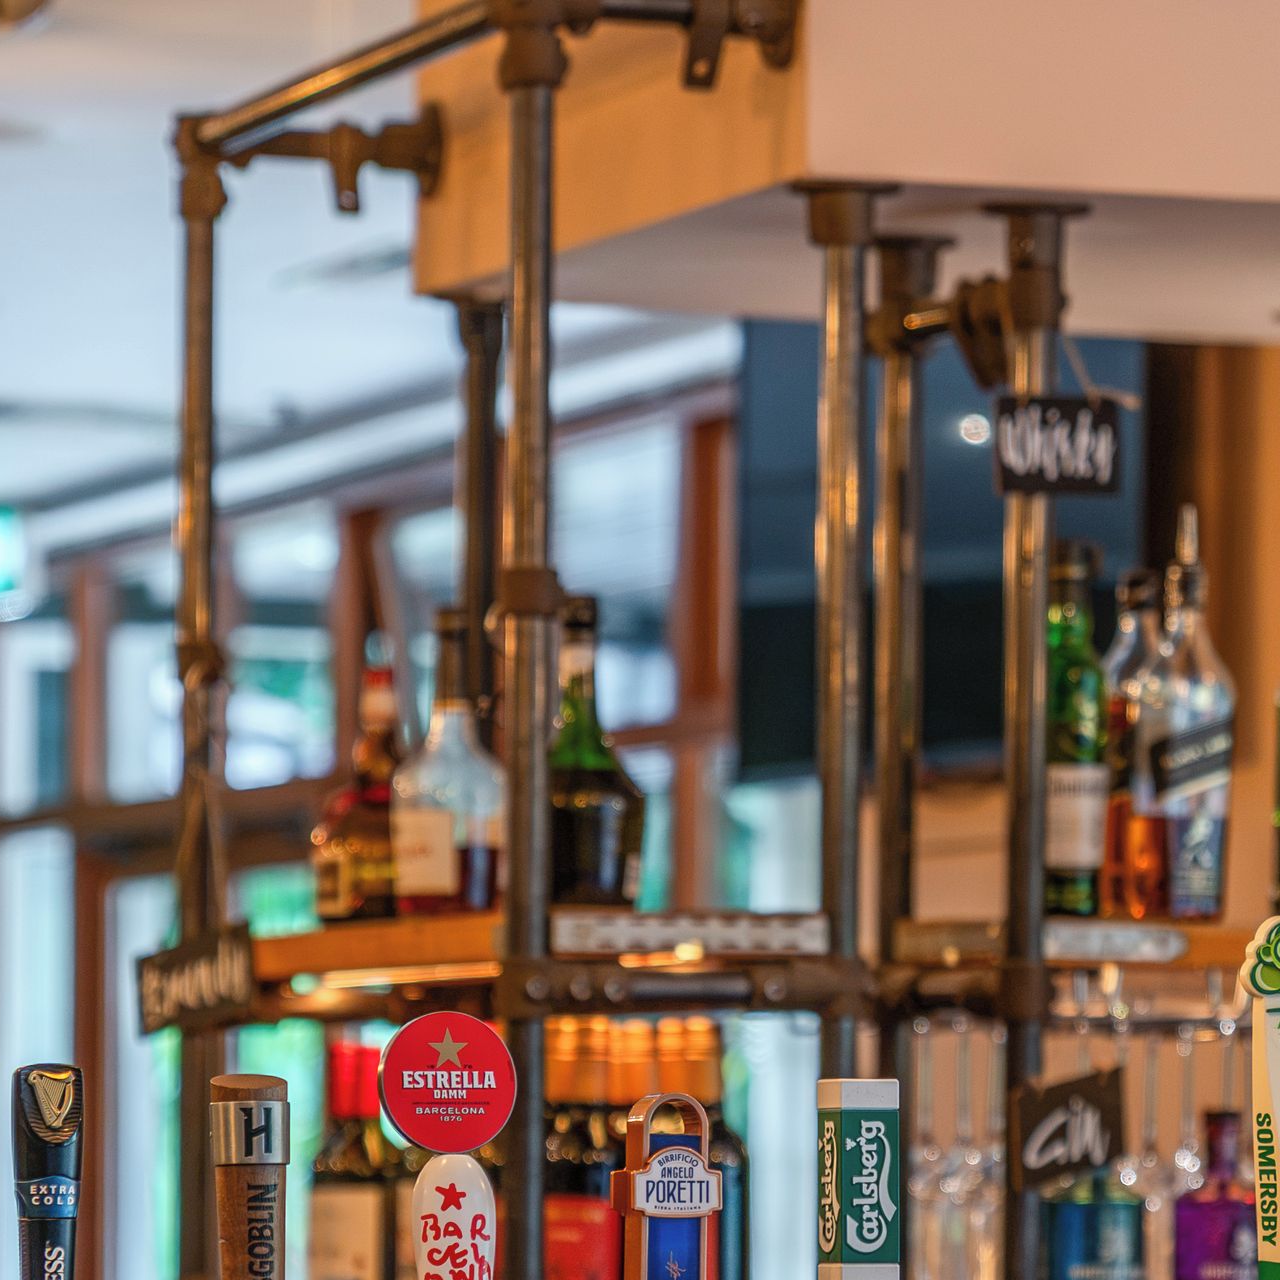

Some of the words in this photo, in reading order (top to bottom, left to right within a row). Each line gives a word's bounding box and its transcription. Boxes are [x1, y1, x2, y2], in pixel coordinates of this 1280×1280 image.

[402, 1071, 497, 1089] ESTRELLA
[433, 1089, 467, 1099] DAMM
[415, 1107, 486, 1115] BARCELONA
[240, 1107, 273, 1158] H
[657, 1153, 699, 1168] BIRRIFICIO
[660, 1167, 695, 1179] ANGELO
[1256, 1113, 1278, 1247] SOMERSBY
[30, 1184, 76, 1195] EXTRA
[645, 1180, 710, 1204] PORETTI
[818, 1119, 841, 1254] Carlsberg
[846, 1119, 898, 1254] Carlsberg
[31, 1196, 75, 1205] COLD
